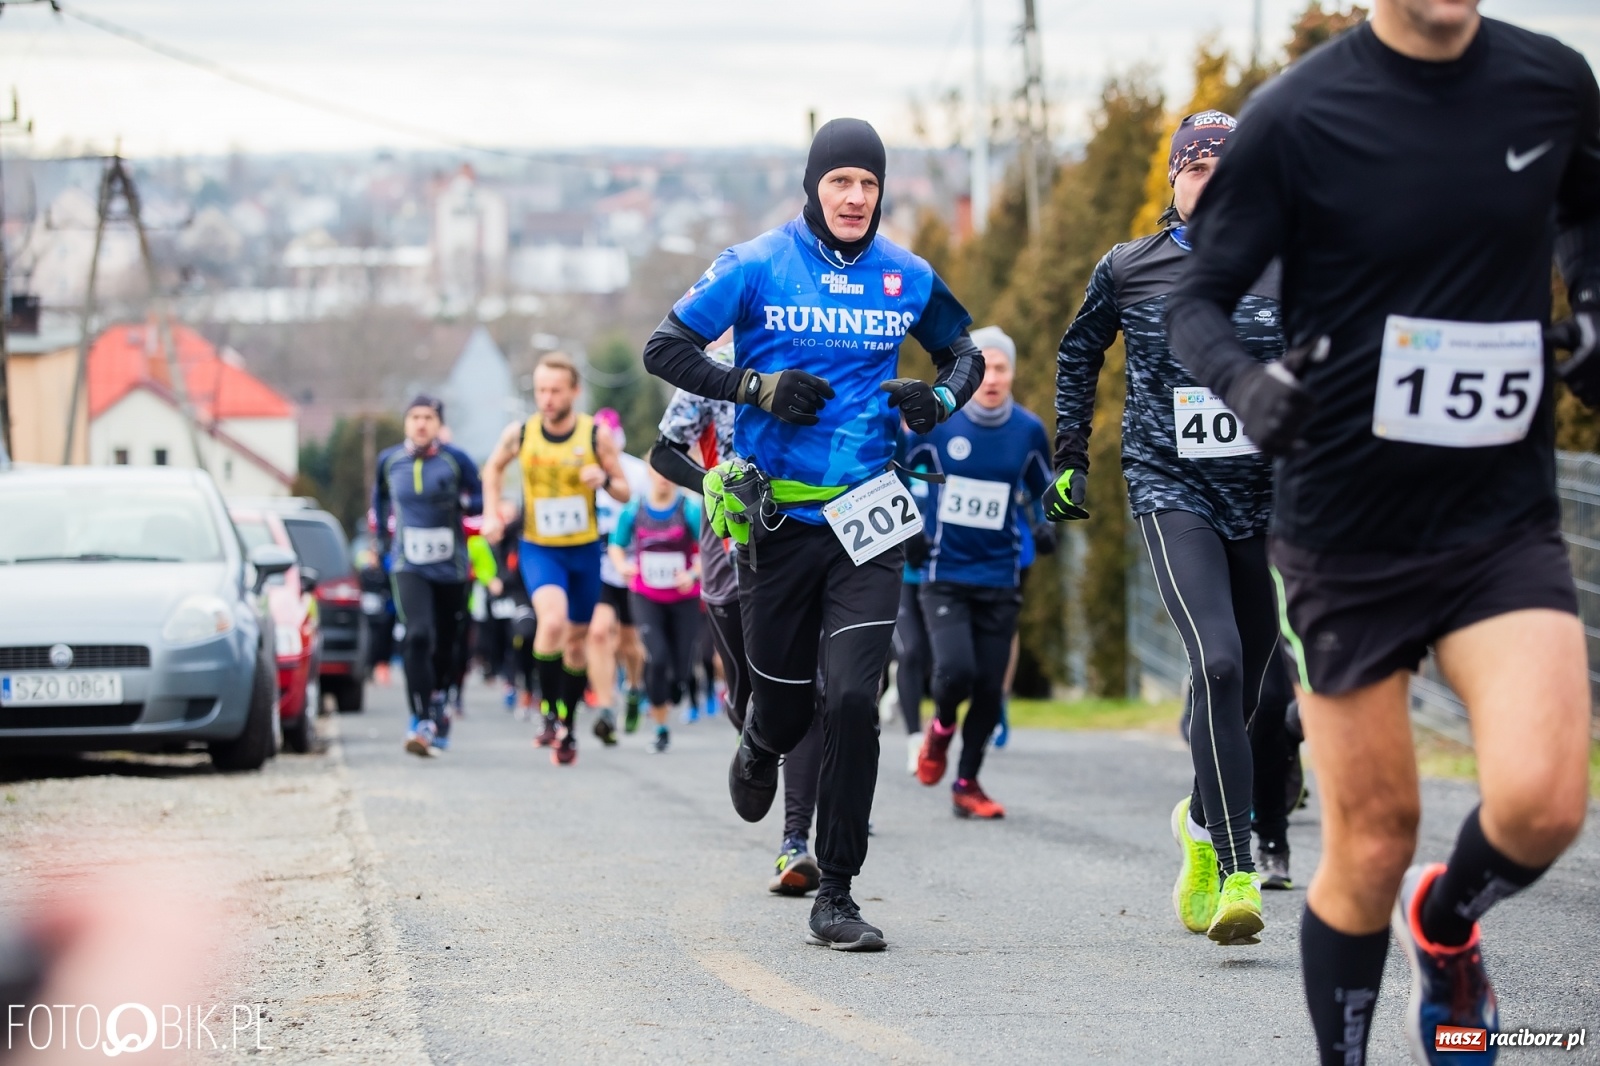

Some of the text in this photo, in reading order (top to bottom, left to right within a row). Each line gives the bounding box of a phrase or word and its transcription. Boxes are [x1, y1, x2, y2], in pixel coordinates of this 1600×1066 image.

[763, 305, 915, 336] RUNNERS
[863, 341, 894, 351] TEAM
[1397, 368, 1530, 420] 155
[1182, 412, 1249, 444] 40
[948, 492, 1000, 519] 398
[842, 495, 917, 552] 202
[15, 676, 60, 700] SZO
